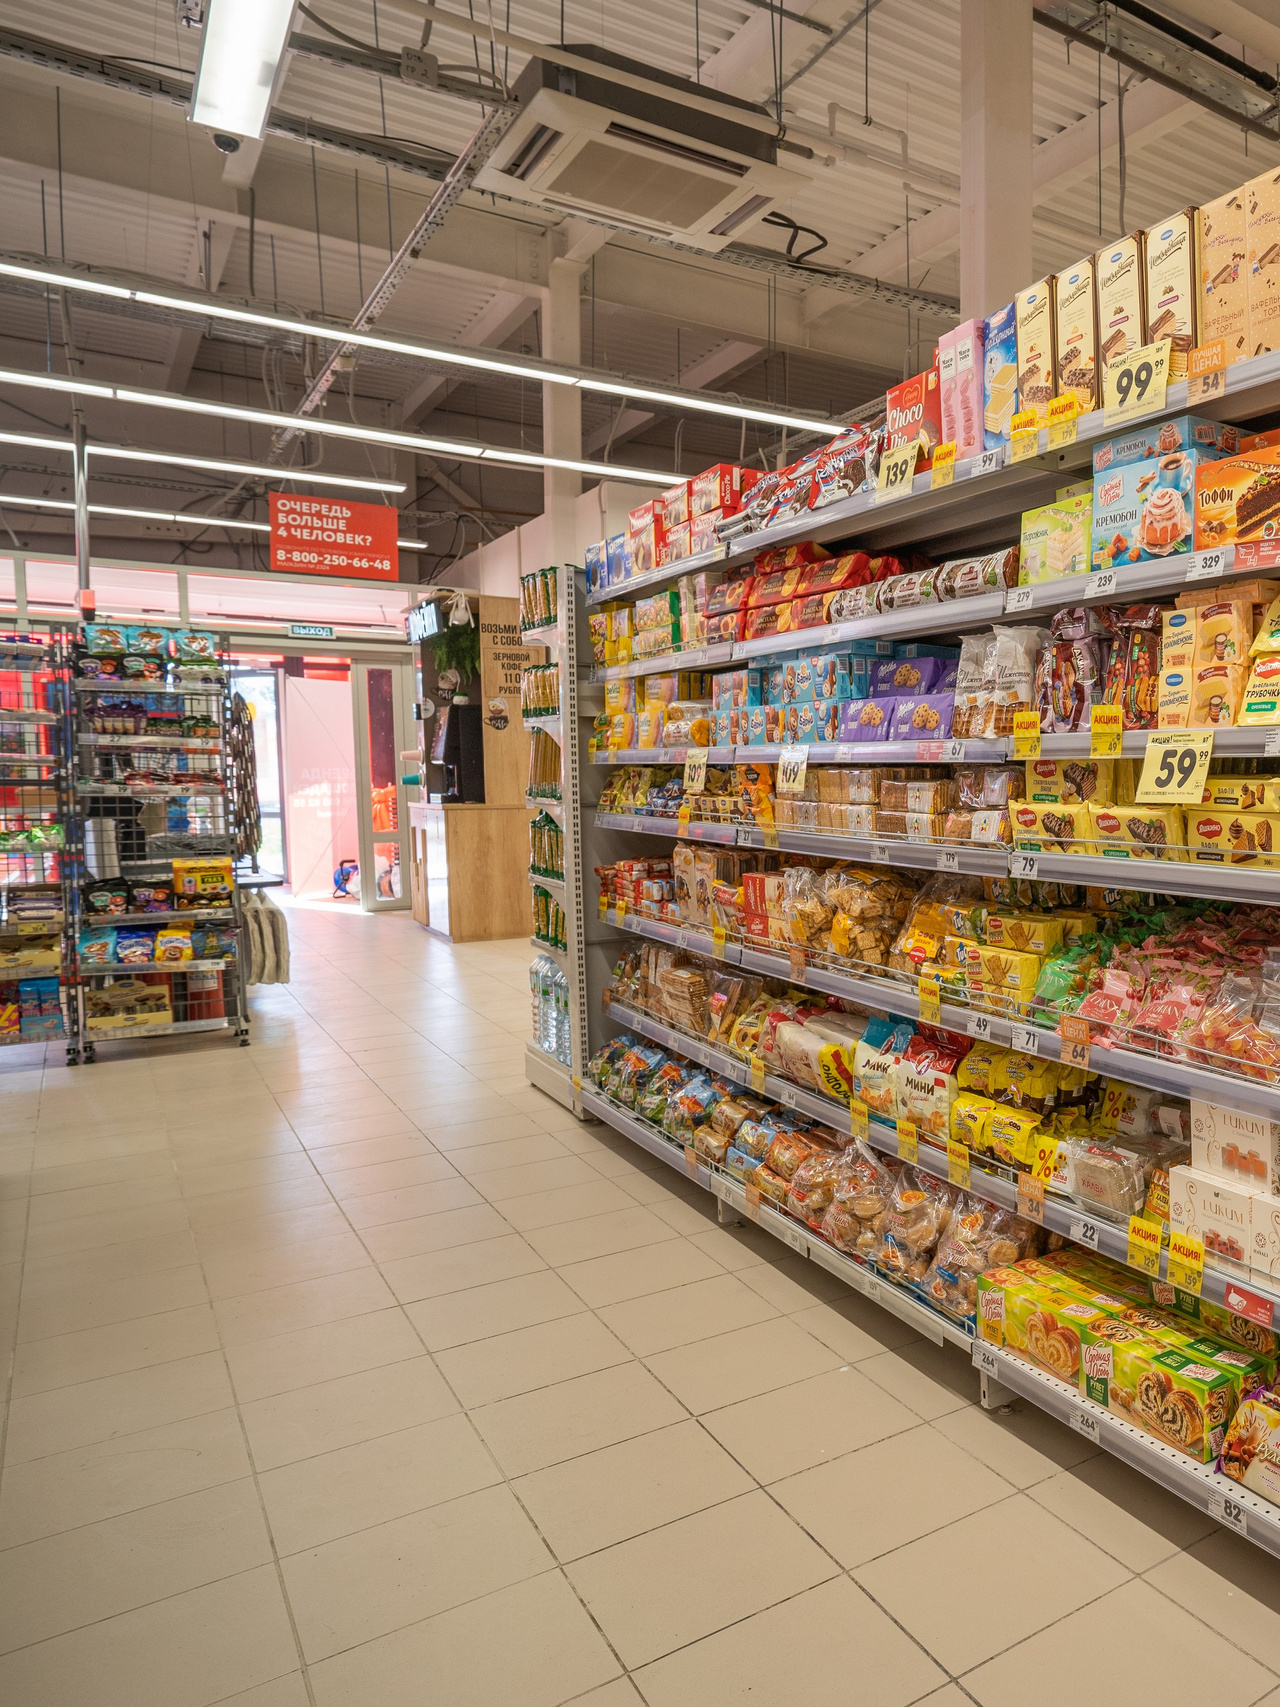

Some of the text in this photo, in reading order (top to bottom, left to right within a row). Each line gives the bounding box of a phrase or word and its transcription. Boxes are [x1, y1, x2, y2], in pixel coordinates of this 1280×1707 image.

[1204, 309, 1244, 330] ВАФЕЛЬНЫЙ
[1116, 361, 1154, 408] 99
[1201, 373, 1220, 394] 54
[888, 402, 923, 433] Choco
[1050, 401, 1075, 418] АКЦИЯ!
[1012, 418, 1035, 431] АКЦИЯ!
[934, 449, 954, 463] АКЦИЯ!
[1116, 440, 1146, 455] КРЕМОБОН
[982, 453, 994, 467] 99
[885, 458, 909, 488] 139
[277, 499, 351, 518] ОЧЕРЕДЬ
[277, 513, 347, 530] БОЛЬШЕ
[1095, 510, 1137, 528] КРЕМОБОН
[277, 527, 372, 546] 4 ЧЕЛОВЕК?
[276, 550, 391, 570] 8-800-250-66-48
[1201, 555, 1220, 569] 329
[1097, 574, 1113, 588] 239
[1016, 591, 1030, 603] 279
[292, 626, 332, 636] ВЫХОД
[481, 623, 517, 634] ВОЗЬМИ
[492, 636, 525, 646] С СОБО
[493, 652, 530, 661] ЗЕРНОВОЙ
[501, 662, 522, 671] КОФЕ
[877, 662, 897, 678] Milka
[898, 702, 915, 718] Milka
[1015, 722, 1038, 731] АКЦИЯ!
[1093, 714, 1120, 725] АКЦИЯ!
[1151, 732, 1174, 745] АКЦИЯ!
[951, 744, 963, 757] 67
[687, 764, 702, 782] 109
[781, 762, 800, 784] 109
[1154, 748, 1209, 789] 59 99
[1022, 856, 1035, 873] 79
[920, 986, 938, 998] АКЦИЯ!
[975, 1017, 988, 1032] 49
[1025, 1031, 1036, 1048] 71
[1063, 1026, 1087, 1041] ЦЕНА!
[1071, 1044, 1086, 1061] 64
[905, 1076, 935, 1096] МИНИ
[898, 1127, 914, 1138] АКЦИЯ!
[1223, 1113, 1265, 1137] LUKUM
[1052, 1173, 1068, 1181] ХАЛВА
[1080, 1177, 1105, 1195] ХАЛВА
[1028, 1199, 1040, 1216] 34
[1203, 1199, 1244, 1225] LUKUM
[1082, 1223, 1096, 1241] 22
[1131, 1225, 1159, 1244] АКЦИЯ!
[1171, 1242, 1201, 1262] АКЦИЯ!
[1184, 1273, 1197, 1288] 159
[981, 1287, 1003, 1314] Сдобная
[986, 1325, 999, 1335] РУЛЕТ
[982, 1352, 995, 1368] 264
[1089, 1380, 1105, 1392] РУЛЕТ
[1080, 1414, 1096, 1432] 264
[1223, 1499, 1243, 1523] 82
